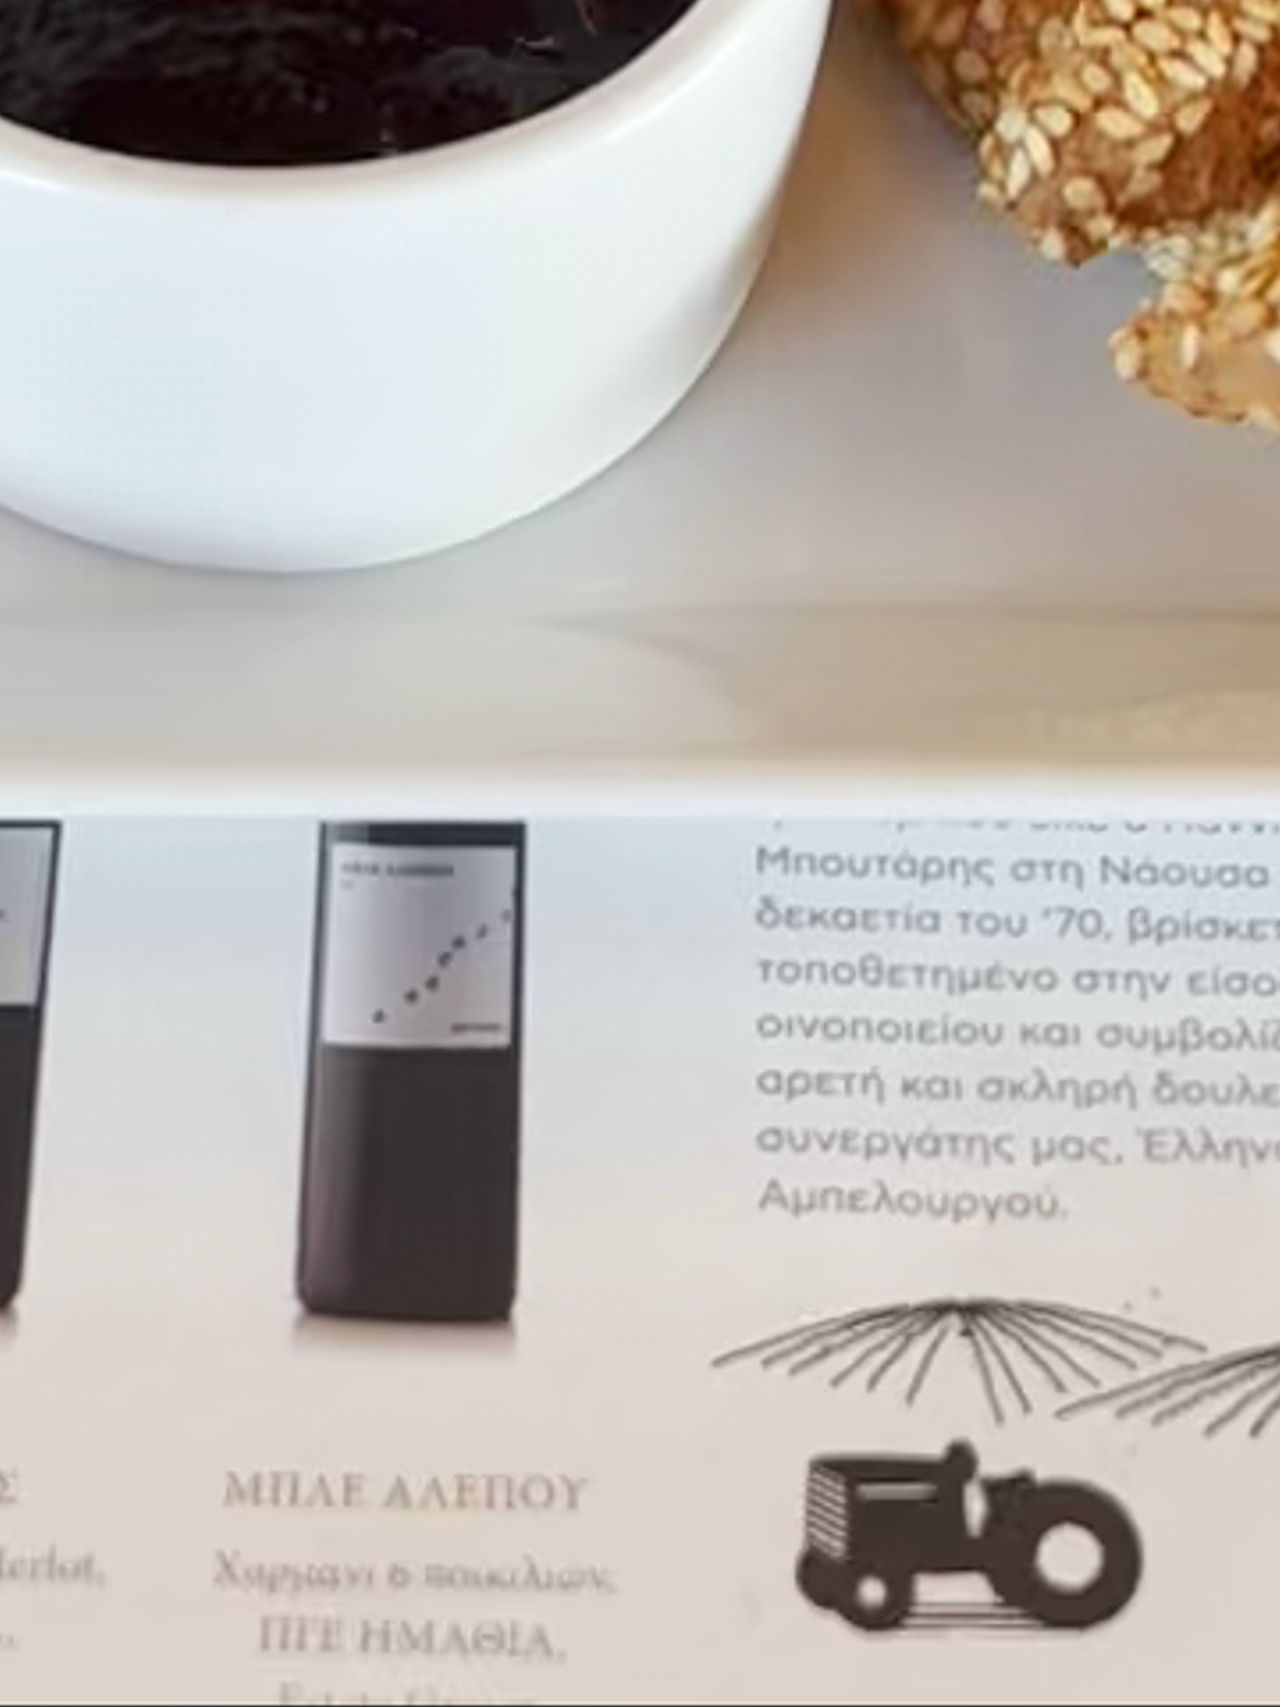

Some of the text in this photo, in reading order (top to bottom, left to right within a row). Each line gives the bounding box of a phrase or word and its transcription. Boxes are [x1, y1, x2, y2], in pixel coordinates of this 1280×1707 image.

[754, 843, 995, 890] Μπουτάρης
[1009, 856, 1085, 892] στη
[1097, 852, 1271, 890] Νάουσα
[753, 894, 942, 936] δεκαετία
[954, 907, 1028, 939] του
[755, 953, 1060, 997] τοποθετημένο
[1072, 968, 1172, 1000] στην
[755, 1010, 1005, 1048] οινοποιείου
[1019, 1021, 1082, 1048] και
[755, 1067, 887, 1104] αρετή
[899, 1077, 963, 1103] και
[976, 1066, 1139, 1113] σκληρή
[755, 1126, 1017, 1167] συνεργάτης
[1030, 1134, 1125, 1168] μας,
[756, 1178, 1070, 1226] Αμπελουργού.
[223, 1471, 589, 1511] ΜΠΛΕ ΑΛΕΠΟΥ
[259, 1615, 567, 1664] ΠΓΕ ΗΜΑΘΙΑ,
